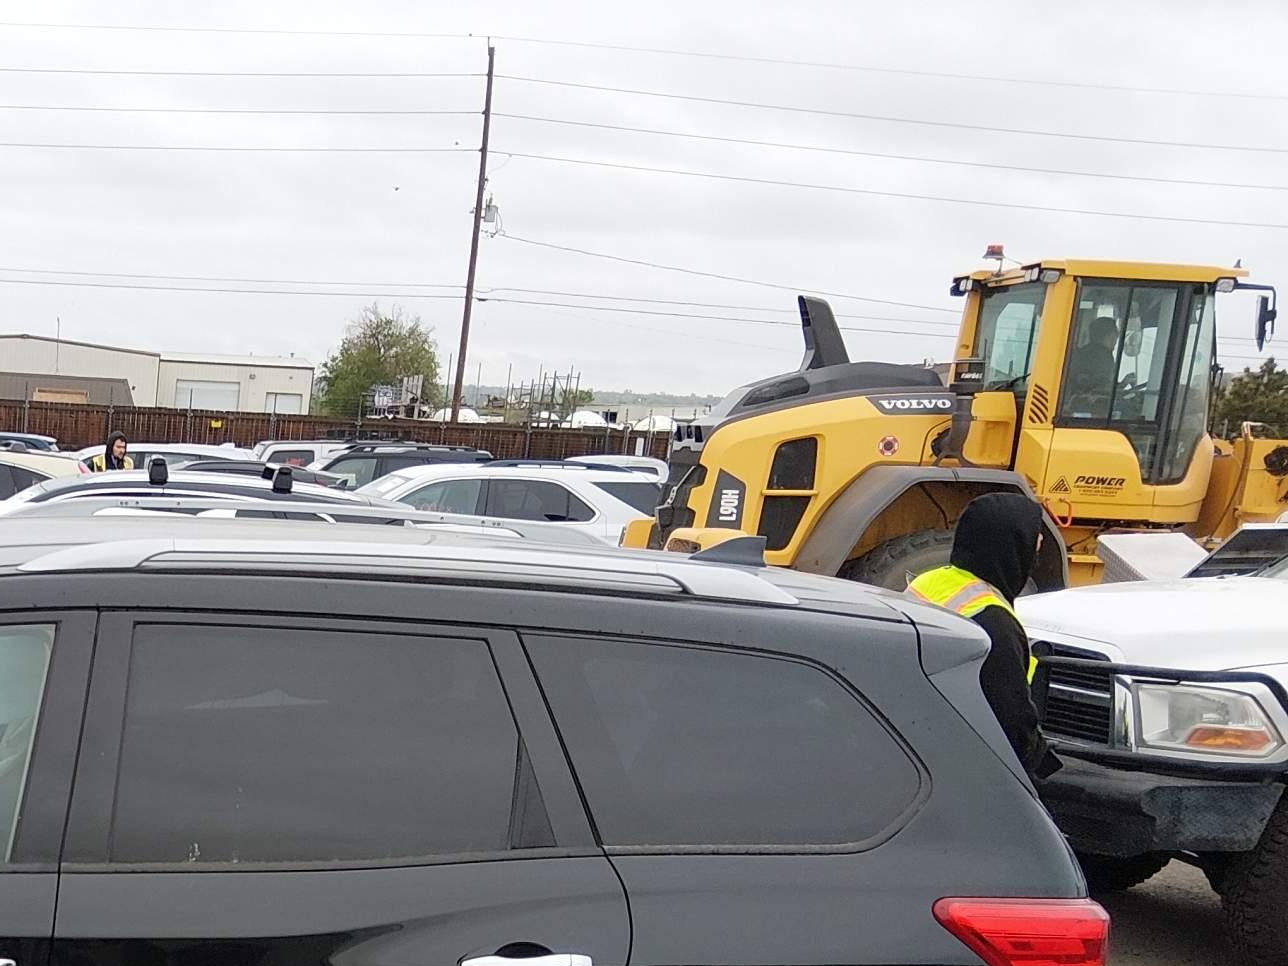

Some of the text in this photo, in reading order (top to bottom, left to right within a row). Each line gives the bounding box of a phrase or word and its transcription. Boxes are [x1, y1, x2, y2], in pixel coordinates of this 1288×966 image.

[878, 399, 952, 409] VOLVO
[1074, 475, 1127, 487] POWER
[718, 489, 740, 521] L90H
